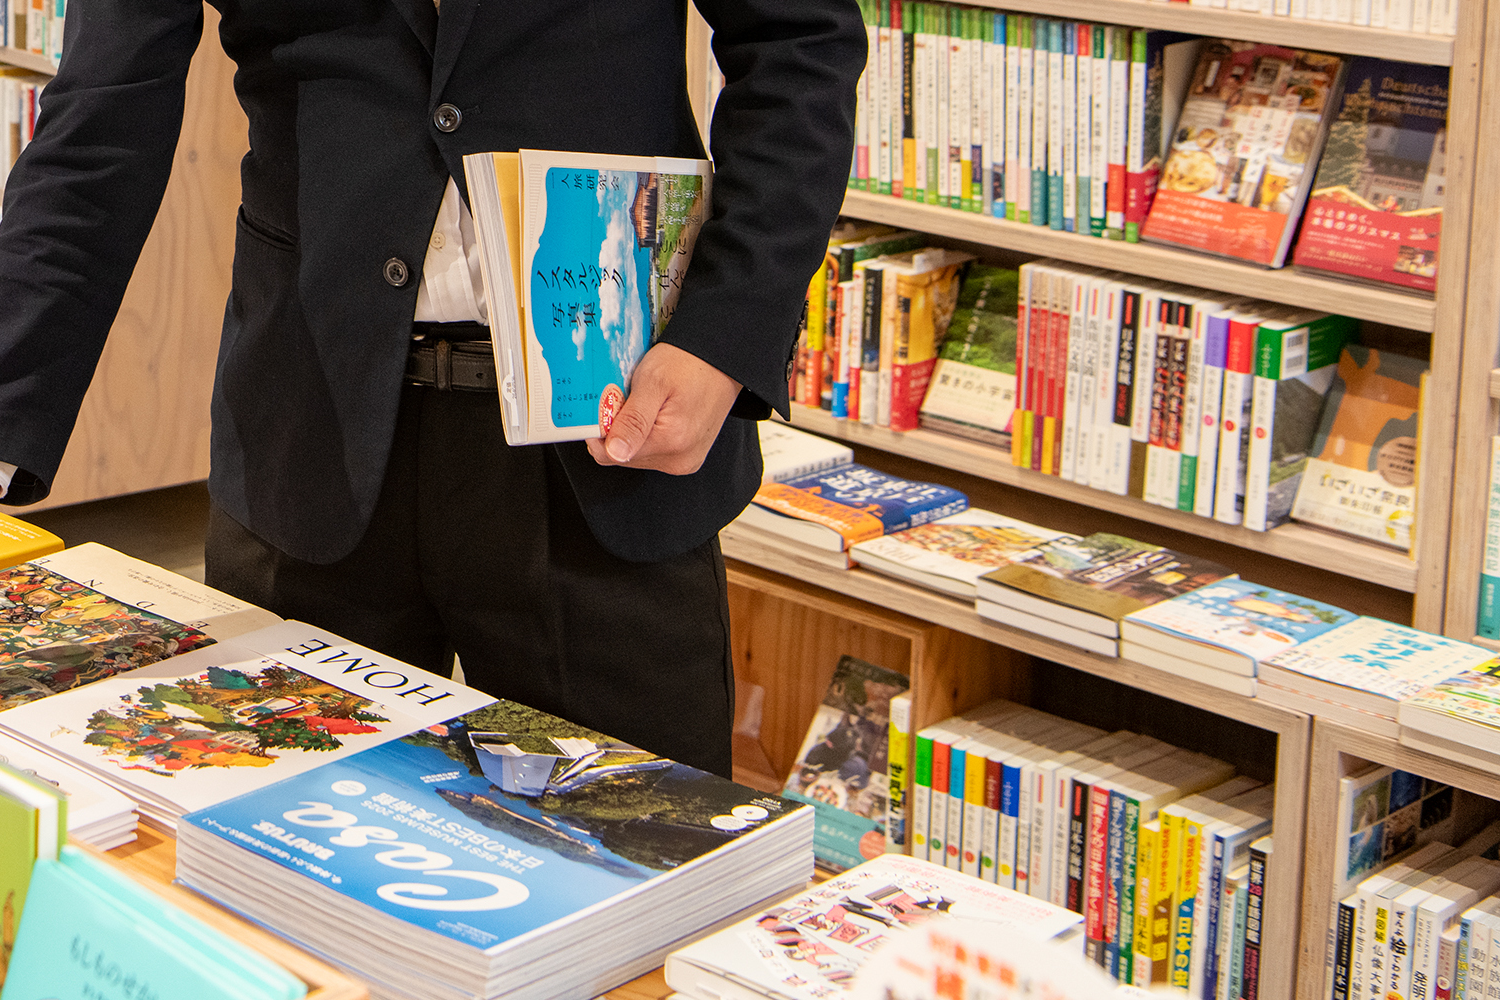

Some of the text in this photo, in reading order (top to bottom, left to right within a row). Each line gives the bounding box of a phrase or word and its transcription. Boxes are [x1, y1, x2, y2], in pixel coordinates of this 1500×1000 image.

[536, 262, 625, 293] ノスタルジック
[552, 302, 598, 328] 写真集
[282, 637, 454, 707] HOME
[254, 821, 336, 862] BRUTUS
[371, 791, 544, 871] 日本のBEST美術館
[392, 811, 463, 848] MUSEUMS
[282, 800, 530, 912] Casa
[461, 840, 497, 863] BEST
[496, 857, 527, 877] THE
